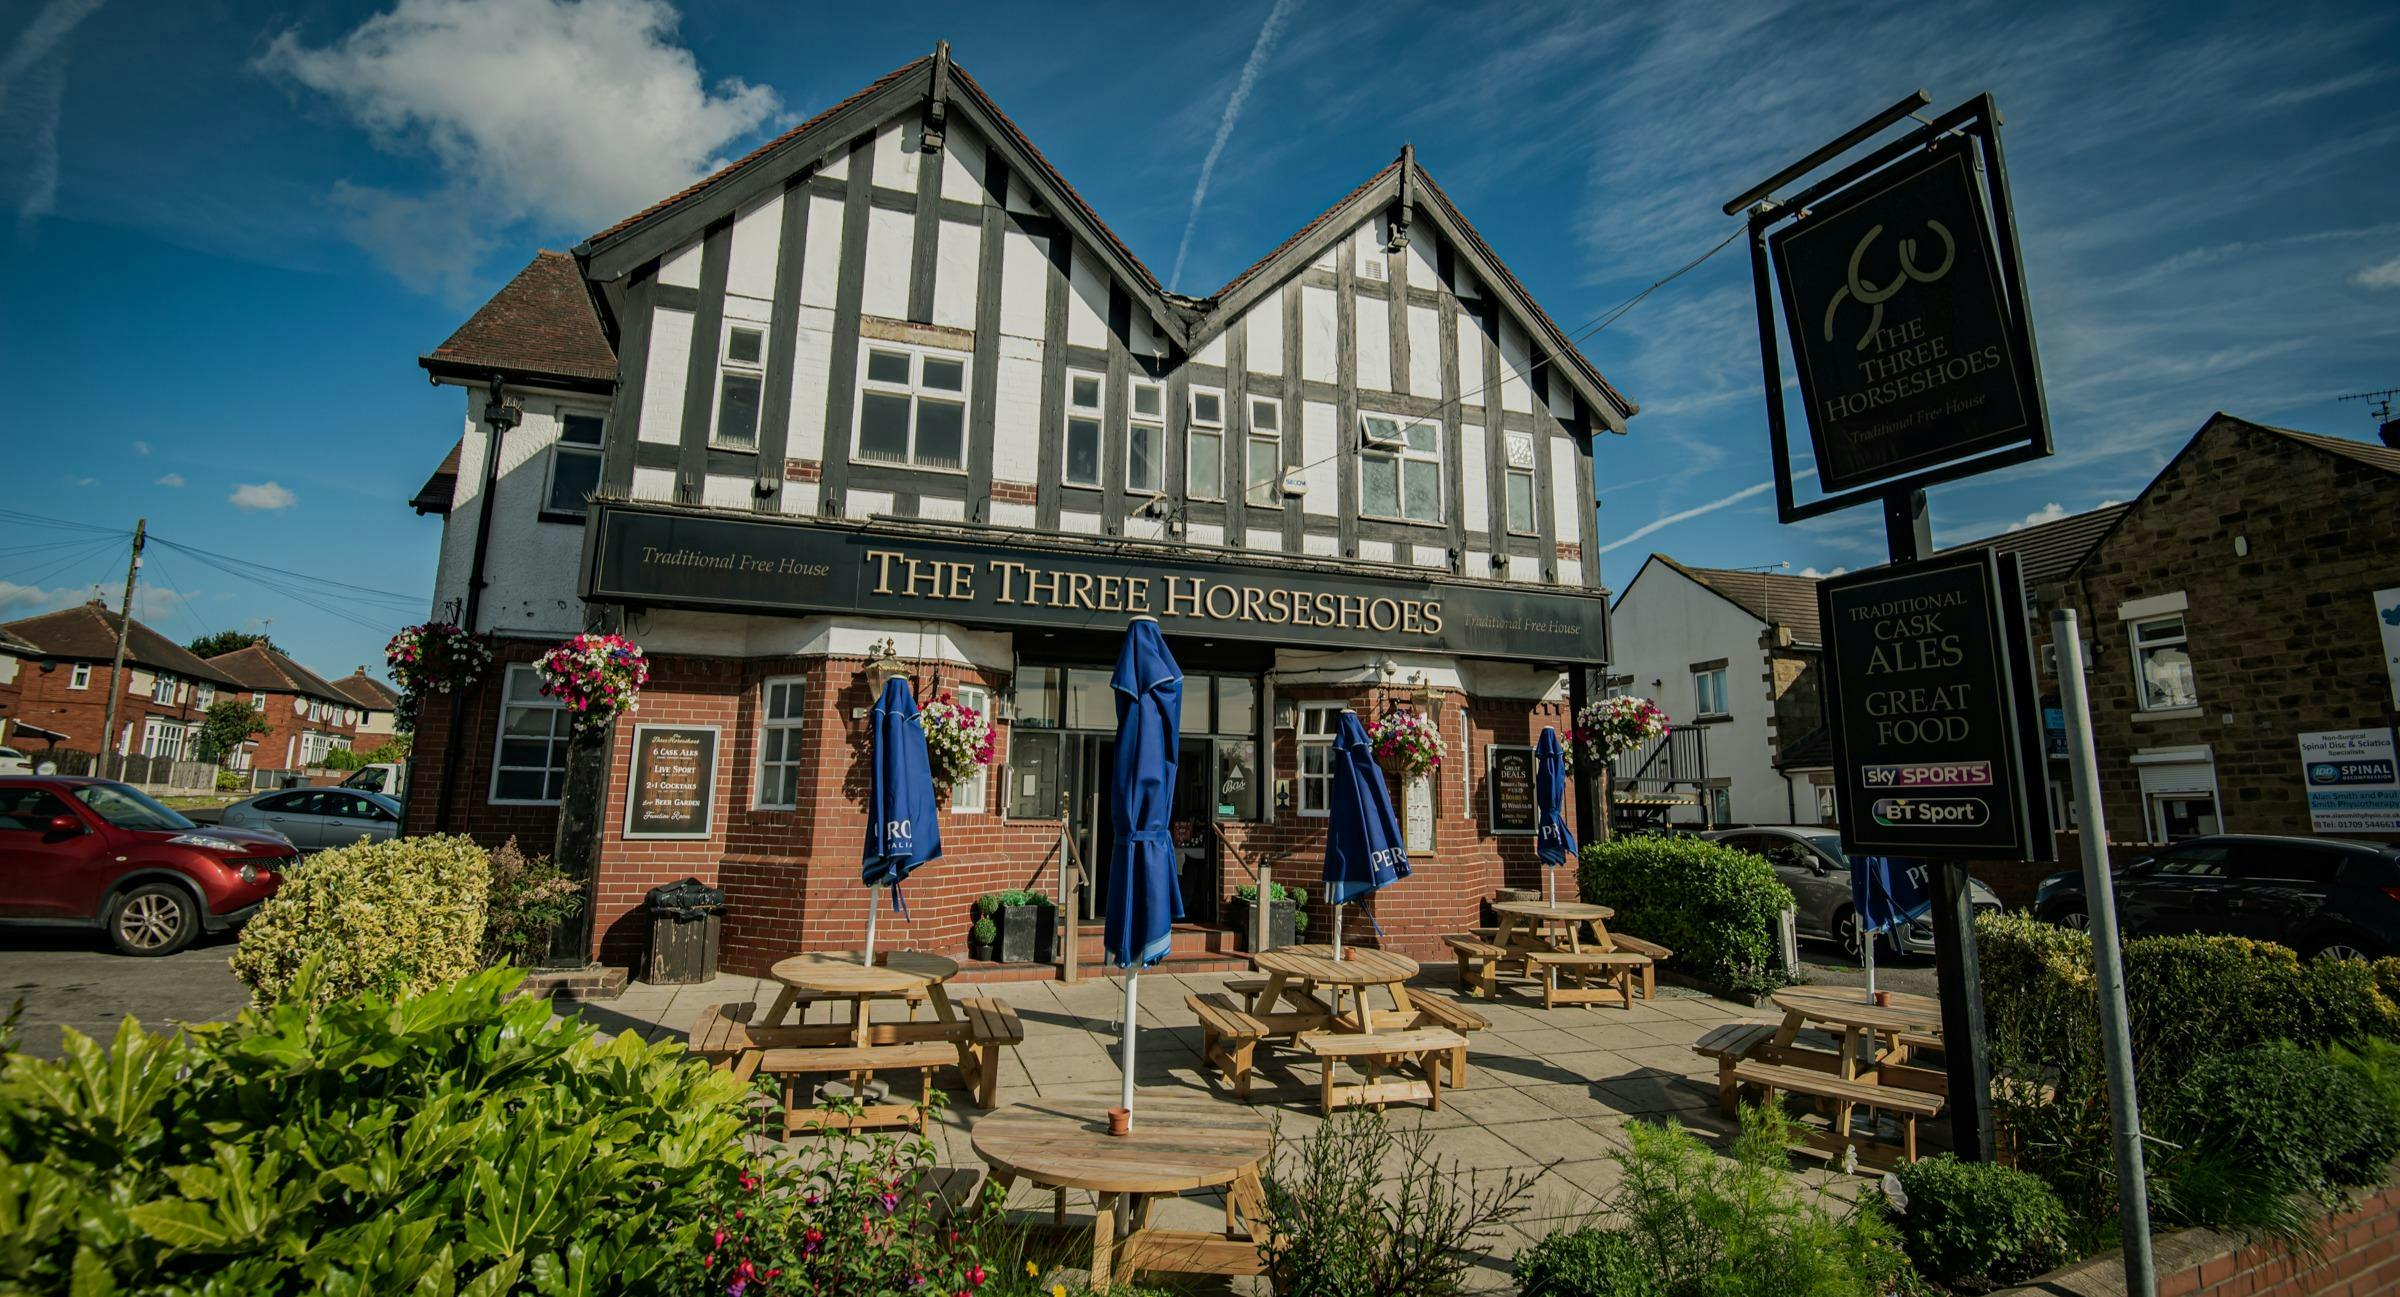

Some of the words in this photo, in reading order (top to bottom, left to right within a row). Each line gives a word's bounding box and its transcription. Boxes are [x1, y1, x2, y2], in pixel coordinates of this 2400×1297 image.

[1874, 317, 1925, 353] THE
[1858, 336, 1948, 383] THREE
[1826, 345, 2001, 422] HORSESHOES
[642, 547, 735, 569] Traditional
[739, 554, 774, 572] Free
[778, 558, 830, 576] House
[866, 550, 975, 600] THE
[989, 560, 1150, 612] THREE
[1162, 575, 1443, 634] HORSESHOES
[1849, 590, 1968, 621] TRADITIONAL
[1464, 614, 1521, 630] Traditional
[1525, 617, 1547, 632] Free
[1549, 620, 1581, 635] House
[1874, 612, 1944, 640] CASK
[1865, 634, 1964, 675] ALES
[1865, 683, 1971, 717] GREAT
[1876, 716, 1969, 745] FOOD
[660, 748, 679, 756] CASK
[2302, 742, 2327, 751] Spinal
[2358, 739, 2391, 747] Sciatica
[654, 765, 671, 773] LIVE
[672, 765, 697, 774] SPORT
[1501, 770, 1526, 779] DEALS
[1867, 768, 1896, 786] sky
[1902, 766, 1986, 783] SPORTS
[2341, 764, 2391, 775] SPINAL
[1886, 805, 1915, 820] BT
[1918, 802, 1975, 823] Sport
